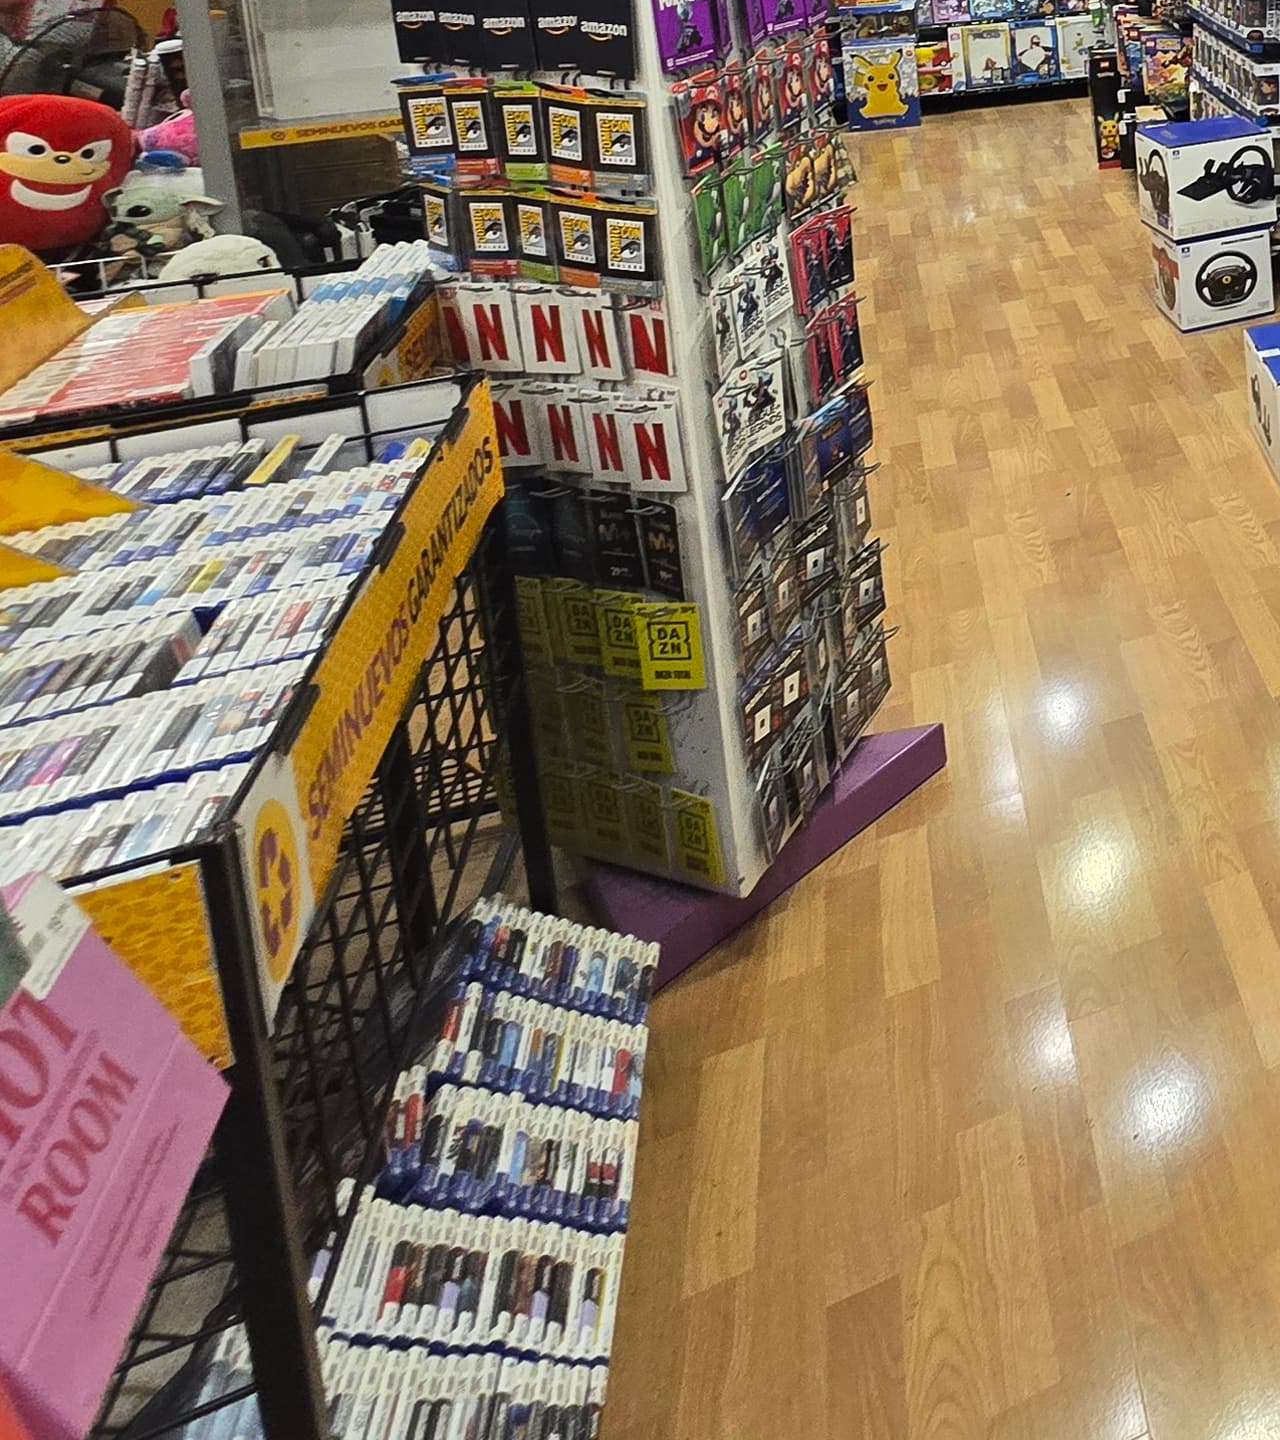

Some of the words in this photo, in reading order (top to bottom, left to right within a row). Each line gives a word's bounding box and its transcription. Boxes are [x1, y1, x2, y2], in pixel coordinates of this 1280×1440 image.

[580, 21, 627, 36] amazon
[600, 119, 613, 156] COMIC
[612, 119, 632, 132] CON
[308, 617, 411, 841] SEMINUEVOS
[406, 434, 495, 629] GARANTIZADOS
[657, 628, 684, 641] DA
[658, 641, 684, 656] ZN
[16, 1049, 138, 1248] ROOM
